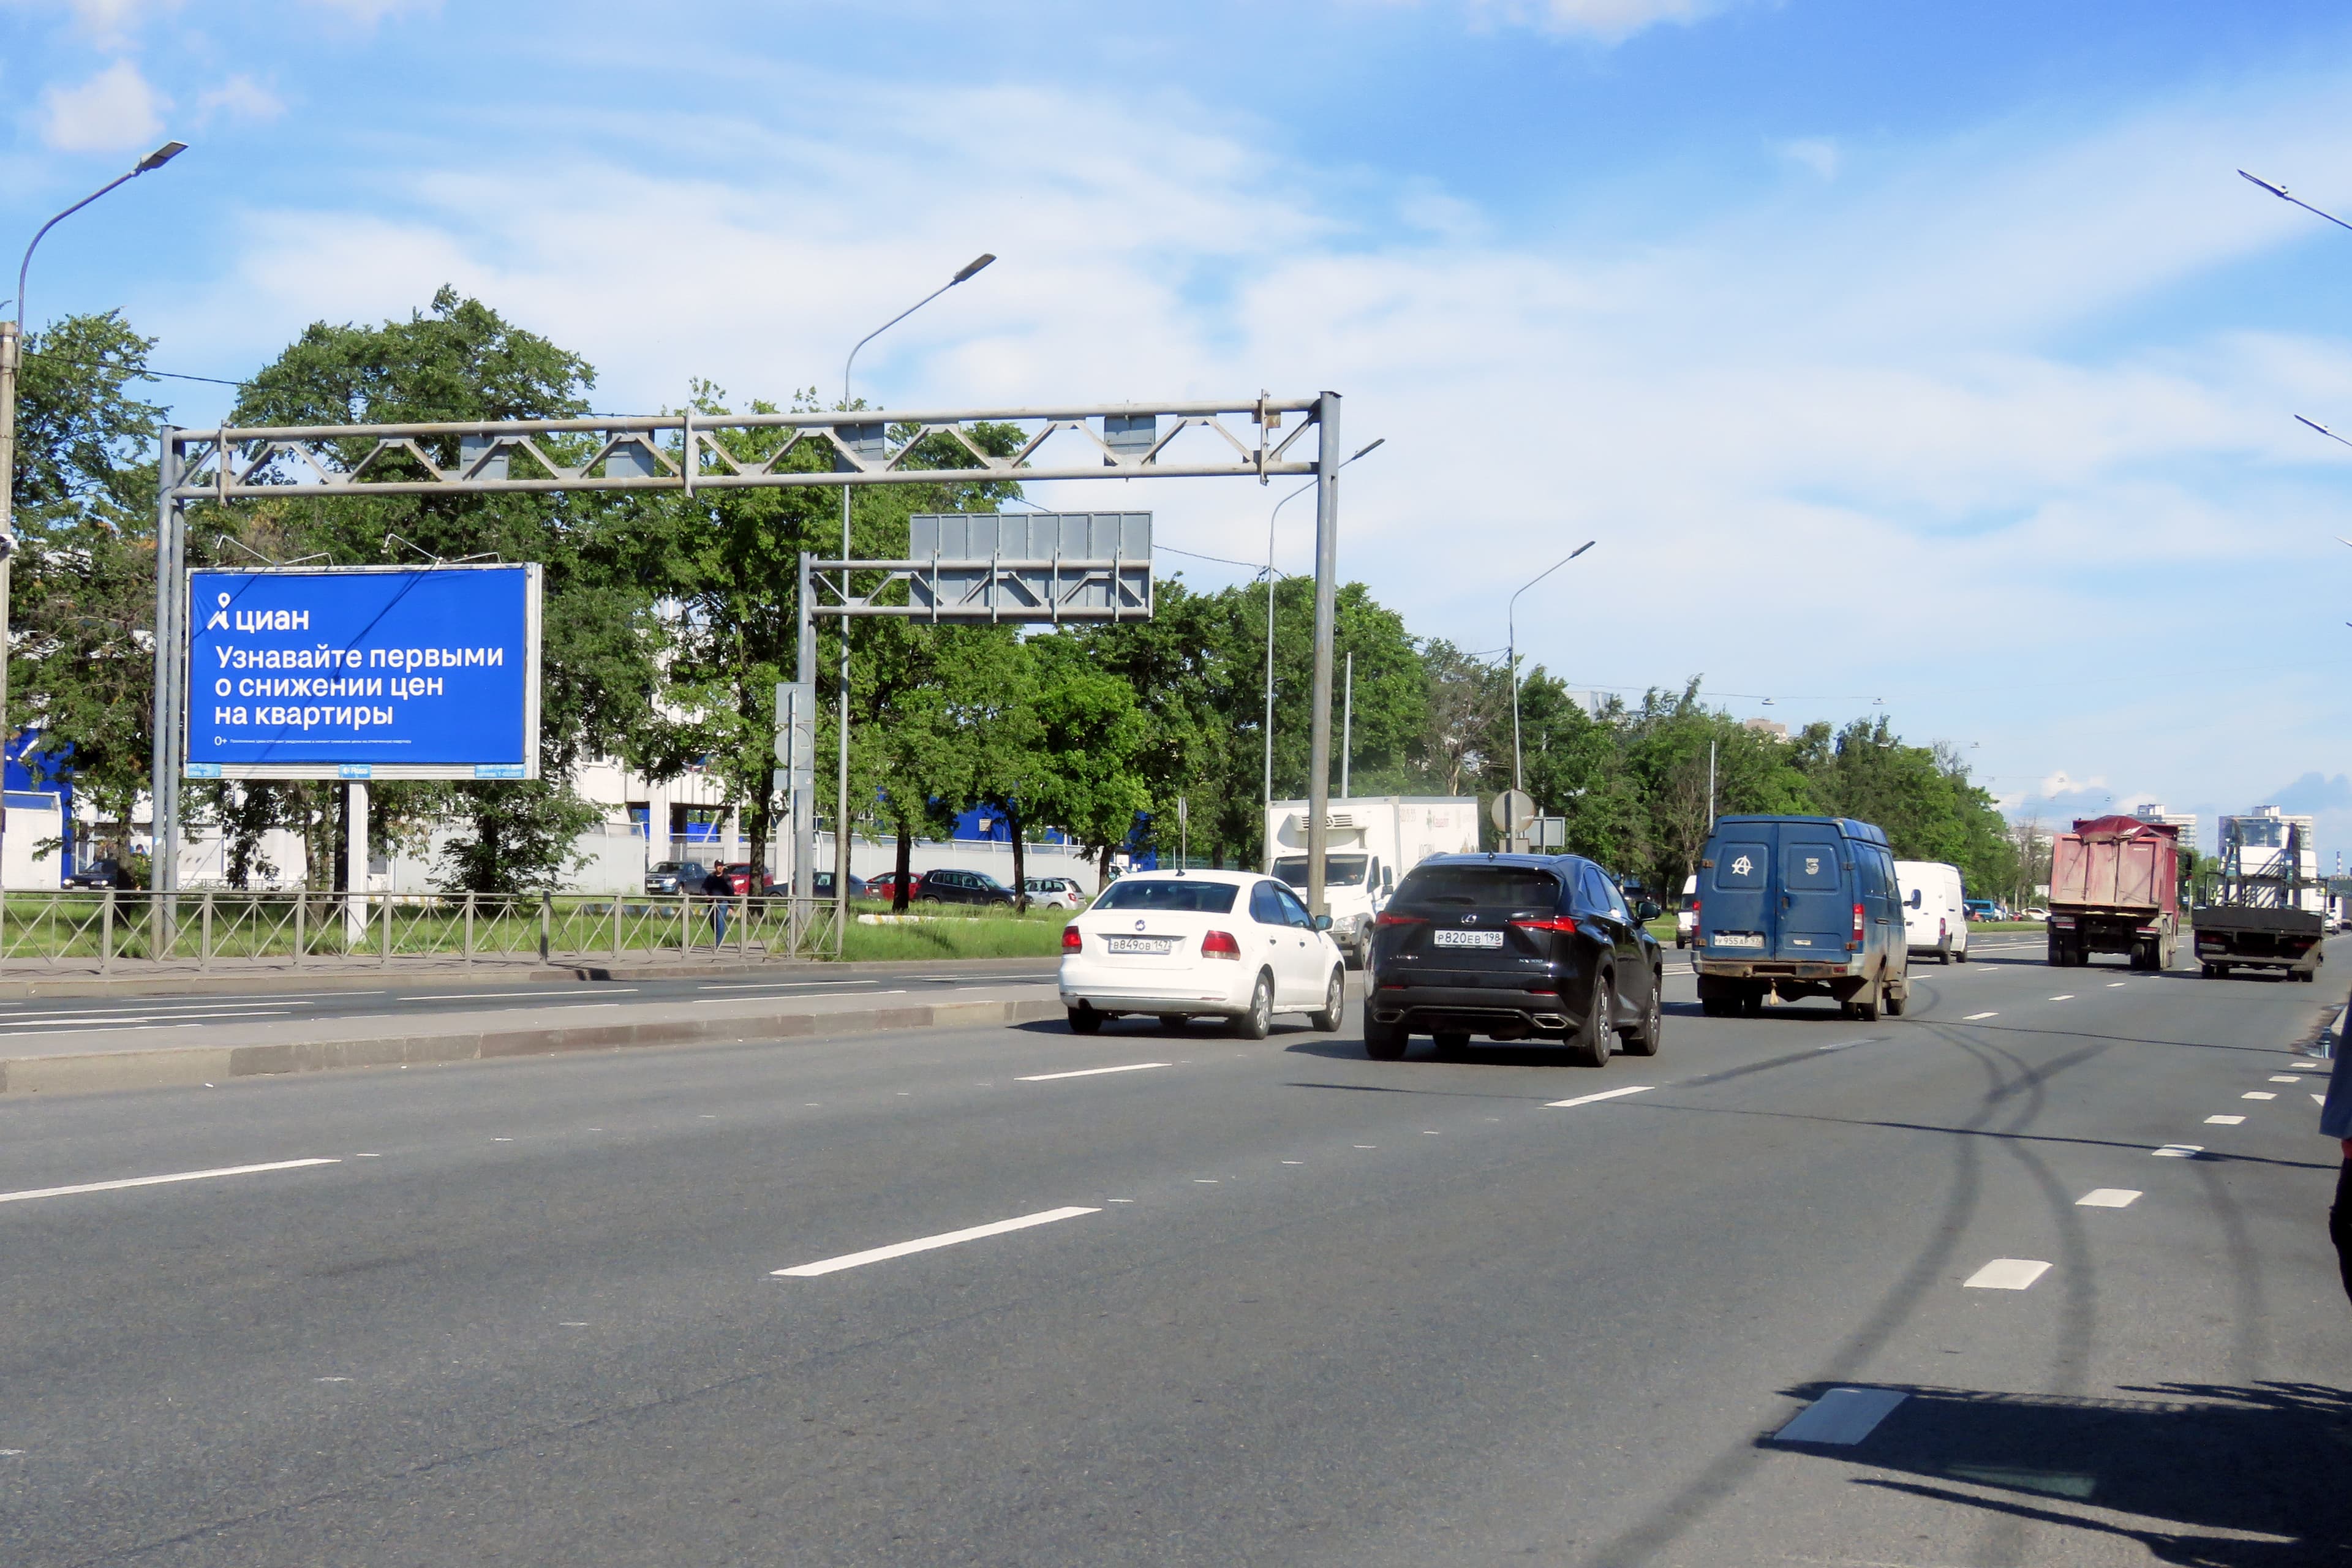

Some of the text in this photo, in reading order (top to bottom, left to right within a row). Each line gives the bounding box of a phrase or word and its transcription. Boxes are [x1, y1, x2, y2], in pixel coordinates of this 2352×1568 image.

[236, 610, 309, 634] циан
[216, 644, 503, 673] Узнавайте первыми
[215, 677, 443, 701] о снижении цен
[215, 706, 393, 731] на квартиры
[214, 736, 227, 746] 0+
[1114, 938, 1151, 951] В849ОВ
[1438, 932, 1501, 944] Р820ЕВ 198
